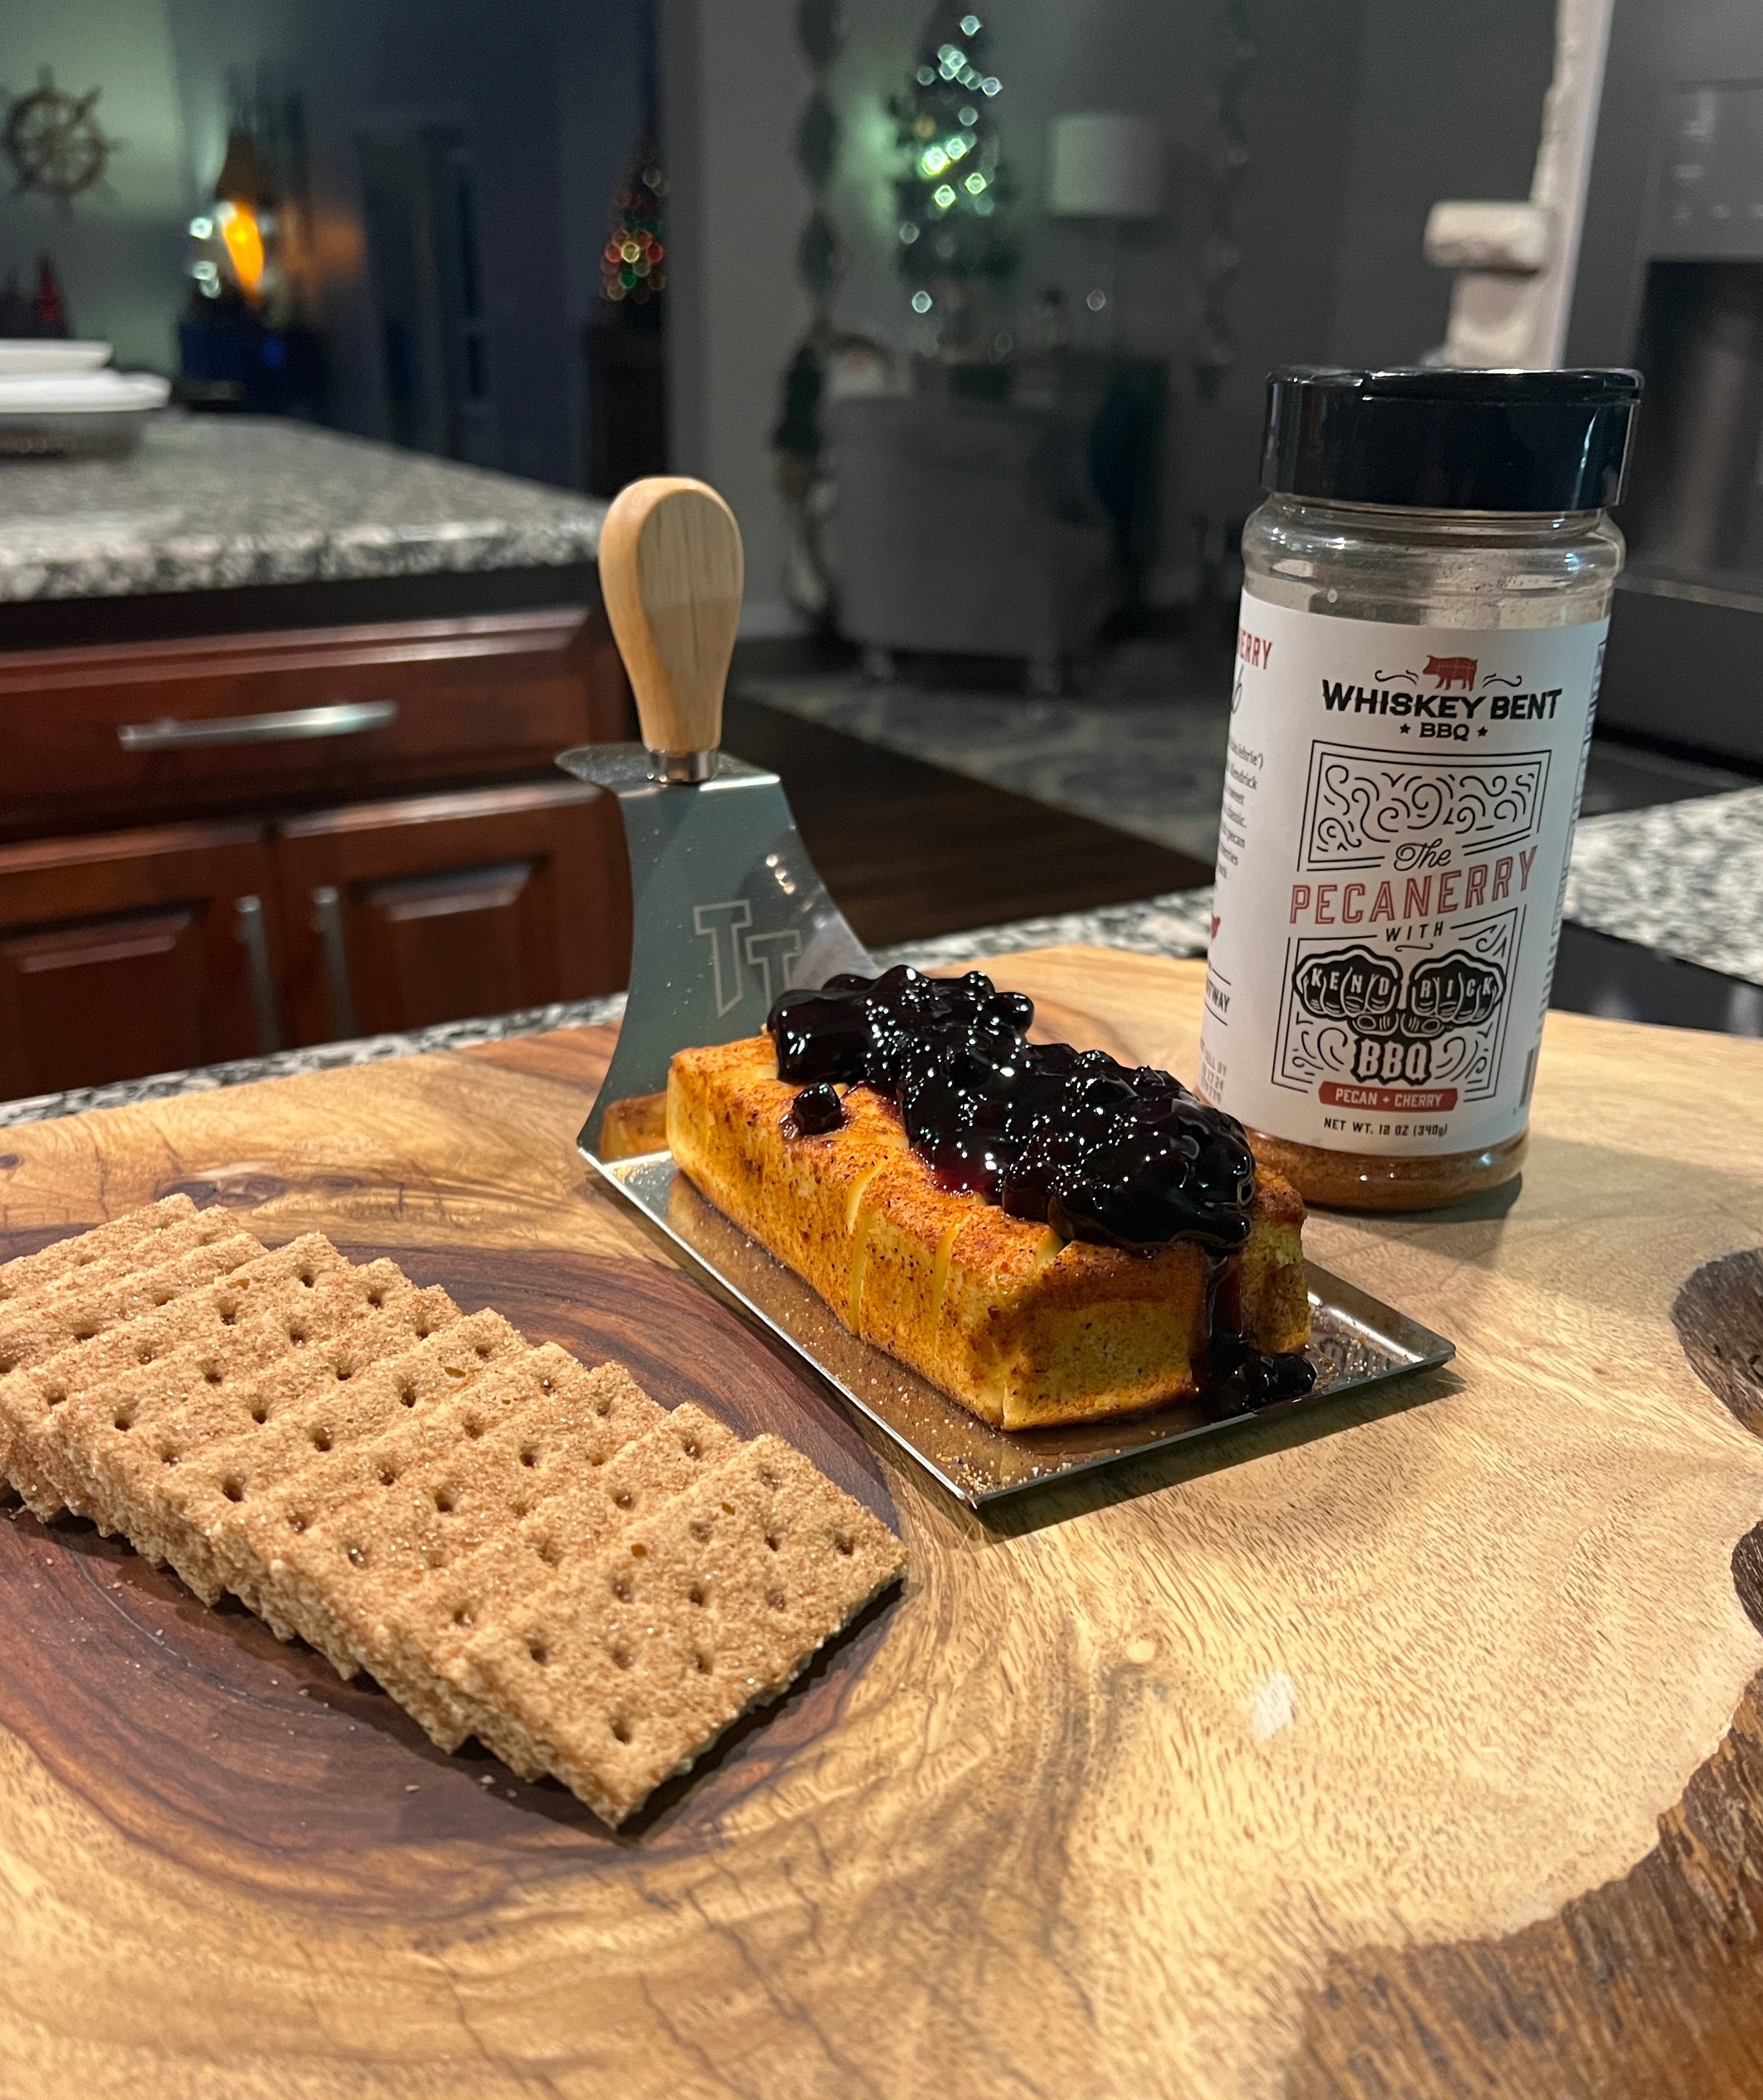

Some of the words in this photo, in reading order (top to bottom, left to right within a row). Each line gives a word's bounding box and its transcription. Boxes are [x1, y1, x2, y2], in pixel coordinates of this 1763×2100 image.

[1322, 679, 1486, 719] WHISKEY
[1490, 688, 1563, 720] BENT
[1419, 722, 1470, 741] BBQ
[1393, 838, 1451, 871] The
[1290, 845, 1538, 925] PECANERRY
[1386, 921, 1444, 942] WITH
[1359, 1038, 1428, 1080] BBQ
[1336, 1088, 1377, 1105] PECAN
[1394, 1093, 1443, 1108] CHERRY
[1324, 1117, 1346, 1131] NET
[1395, 1124, 1409, 1136] OZ
